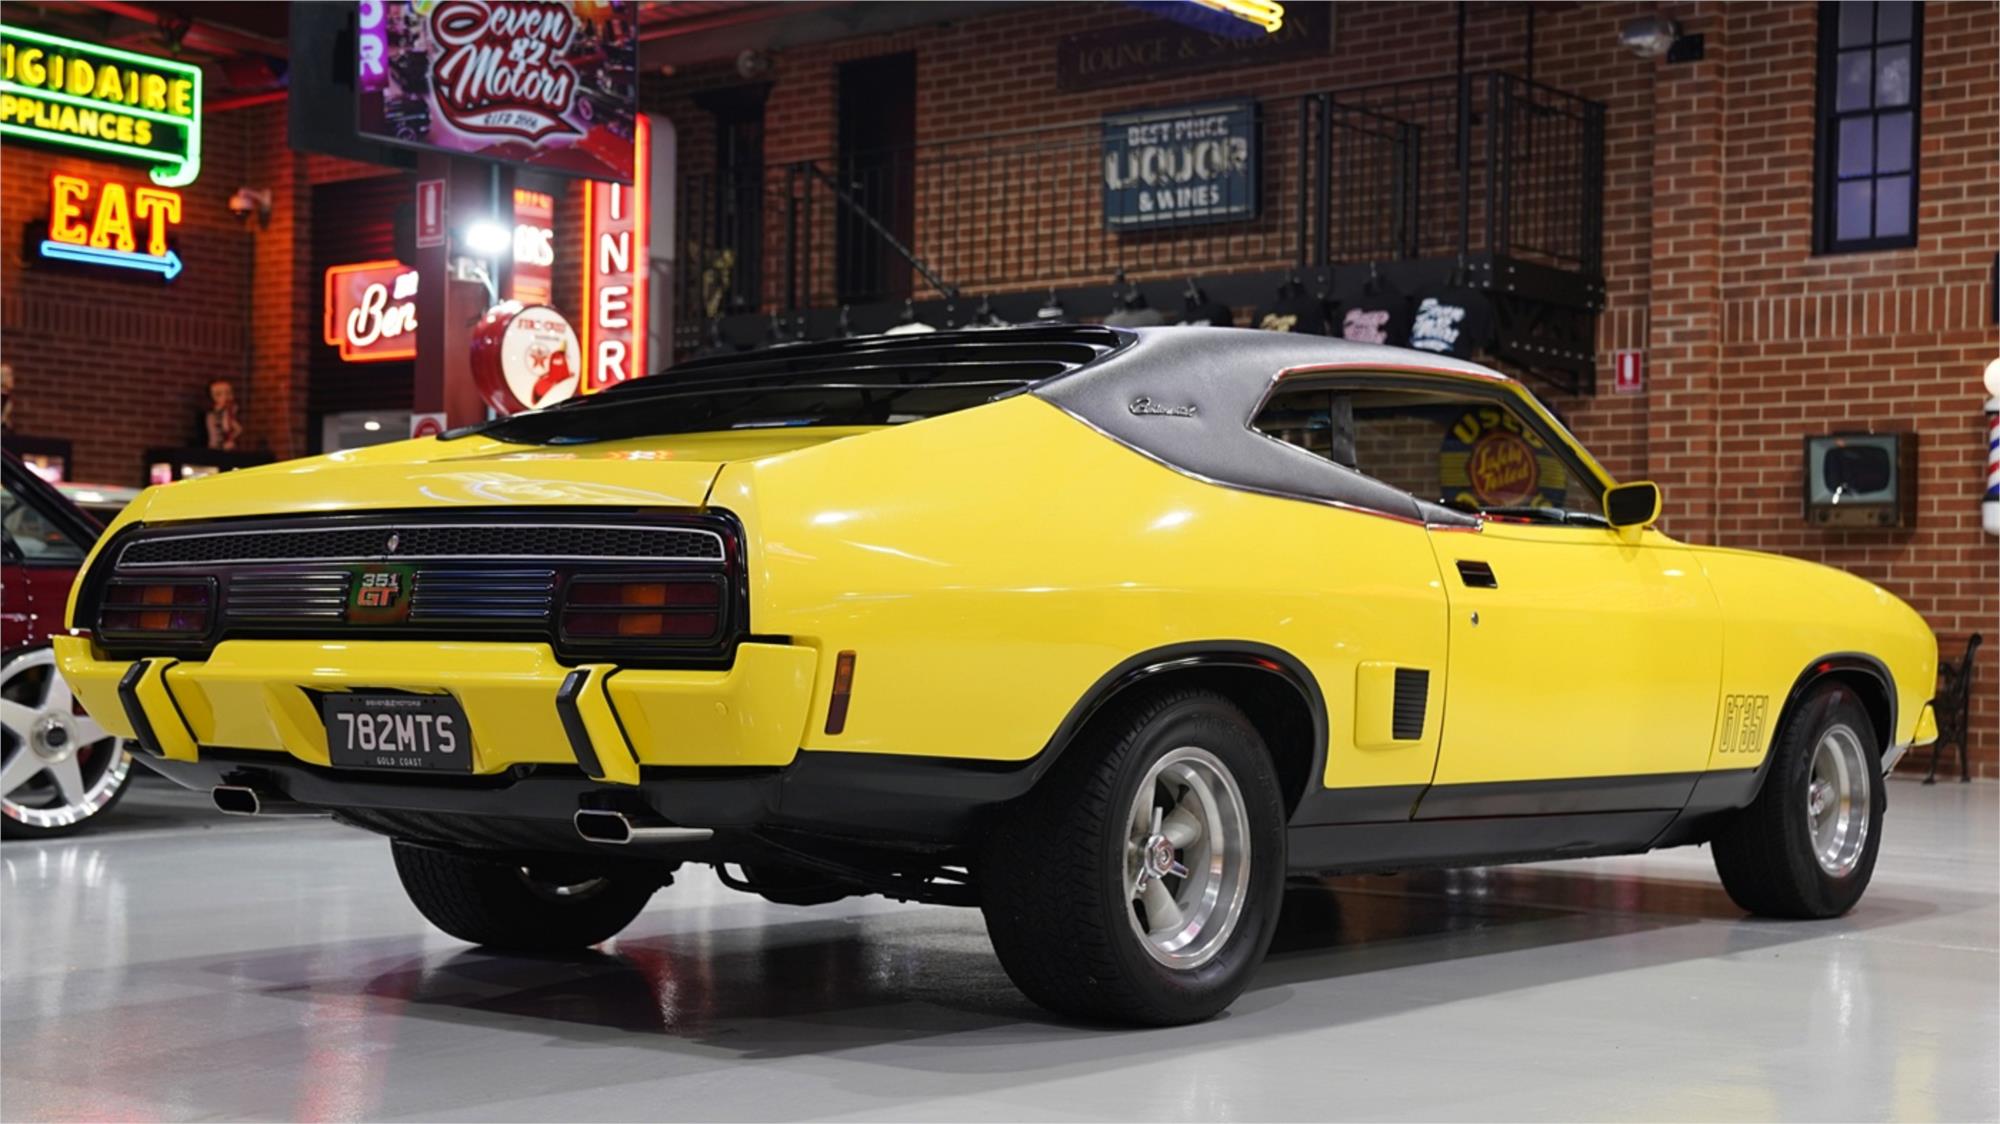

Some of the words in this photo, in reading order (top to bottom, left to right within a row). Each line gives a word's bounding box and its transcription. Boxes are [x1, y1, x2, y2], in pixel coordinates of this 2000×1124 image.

[436, 1, 566, 45] Seven
[508, 36, 547, 66] 82
[1078, 37, 1169, 75] LOUNGE
[1177, 37, 1196, 60] &
[440, 44, 570, 107] Motors
[1127, 121, 1172, 147] BEST
[1175, 115, 1229, 140] PRICE
[1104, 137, 1249, 191] LIQUOR
[51, 175, 182, 257] EAT
[1138, 191, 1153, 212] &
[1156, 185, 1220, 210] WINES
[357, 586, 399, 606] GT
[362, 573, 399, 587] 351
[337, 713, 456, 753] 782MTS
[1719, 694, 1770, 753] GT351
[376, 756, 395, 766] GOLD
[399, 757, 422, 767] COAST
